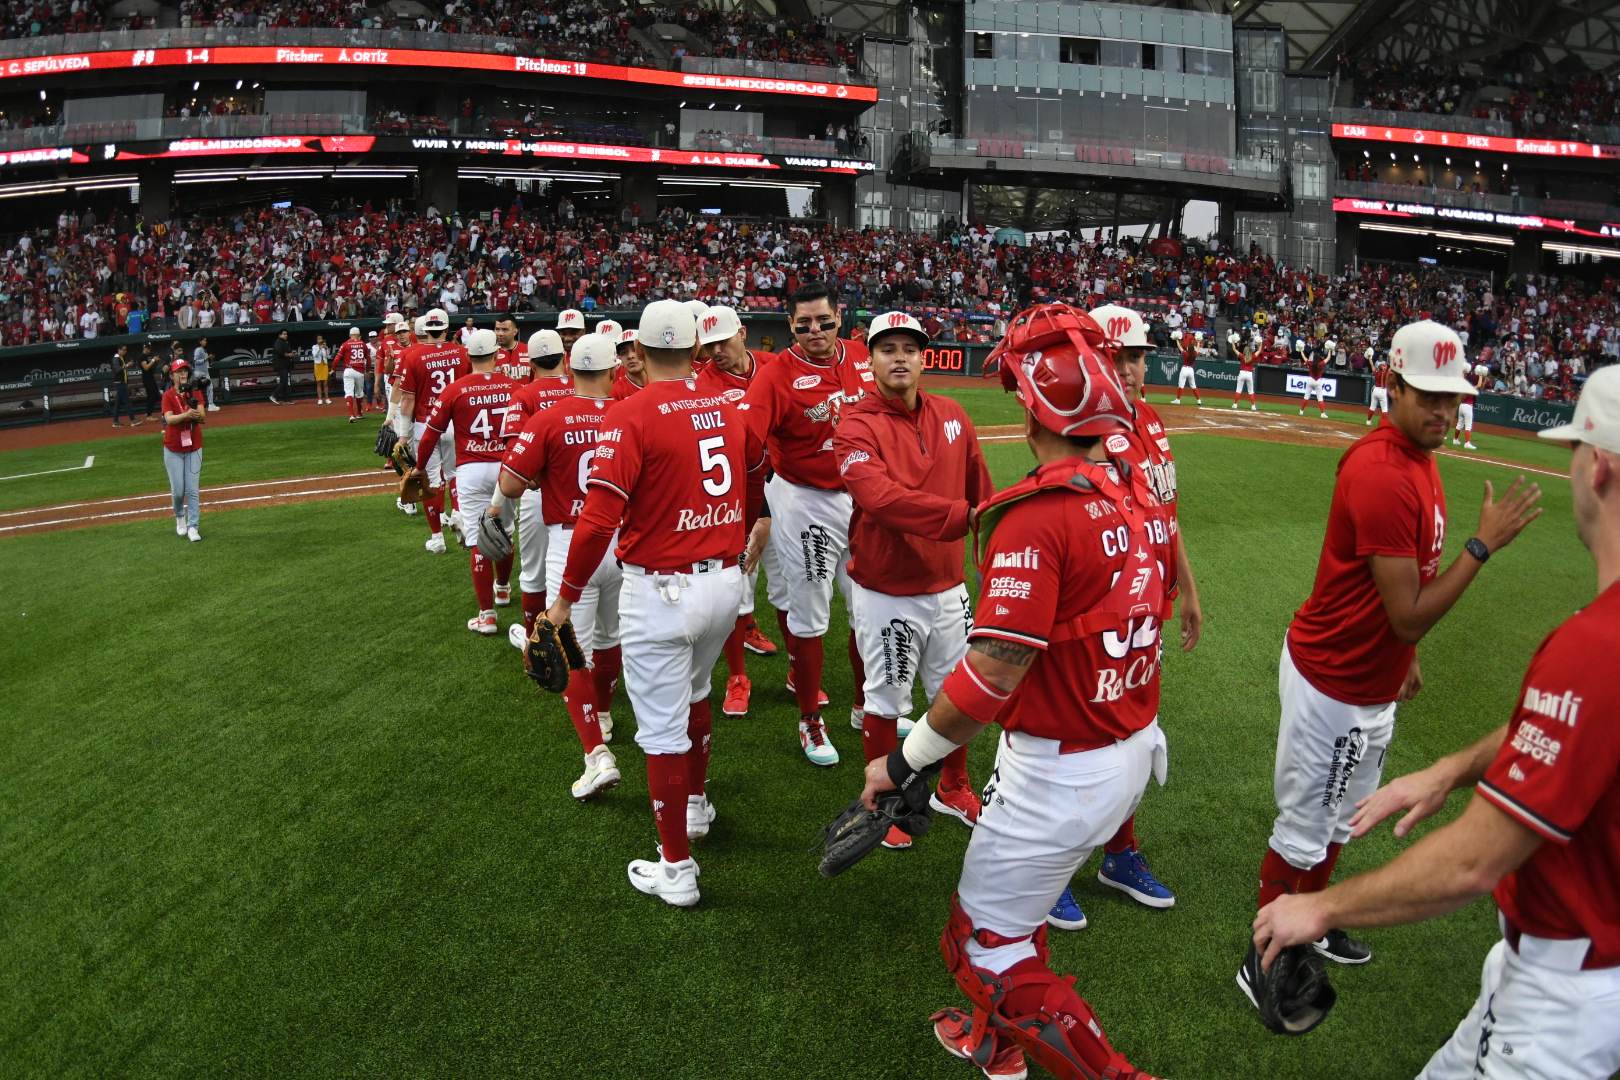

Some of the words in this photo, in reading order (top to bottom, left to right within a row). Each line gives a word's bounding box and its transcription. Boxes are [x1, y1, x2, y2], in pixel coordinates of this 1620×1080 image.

[187, 49, 209, 63] 1-4
[277, 49, 323, 62] Pitcher:
[353, 50, 388, 62] ORTÍZ
[9, 63, 21, 73] C.
[24, 56, 90, 71] SEPÚLVEDA
[515, 56, 571, 74] Pitcheos:
[574, 63, 587, 75] 19
[683, 75, 828, 95] #DELMEXICOROJO
[1343, 126, 1366, 137] CAM
[1385, 130, 1392, 140] 4
[168, 139, 302, 152] #DELMEXICOROJO
[412, 139, 448, 149] VIVIR
[452, 140, 462, 149] Y
[465, 140, 509, 151] MORIR
[513, 143, 575, 154] JUGANDO
[1441, 134, 1447, 144] 5
[1466, 136, 1489, 148] MEX
[1516, 139, 1556, 154] Entrada
[691, 155, 700, 164] A
[704, 156, 722, 165] LA
[725, 158, 770, 167] DIABLA
[784, 156, 828, 168] VAMOS
[1351, 200, 1383, 211] VIVIR
[1385, 202, 1395, 212] Y
[1397, 204, 1435, 216] MORIR
[1438, 207, 1494, 222] JUGANDO
[350, 348, 364, 359] 36
[922, 348, 962, 370] 0:00
[426, 357, 461, 370] ORNELAS
[430, 367, 456, 395] 31
[468, 382, 513, 393] INTERCERAMIC
[469, 392, 512, 406] GAMBOA
[546, 388, 576, 397] INTERCE
[670, 394, 730, 412] INTERCERAMIC
[1474, 404, 1500, 414] CERAMIC
[469, 406, 508, 440] 47
[575, 414, 606, 423] INTERC
[690, 410, 726, 431] RUIZ
[697, 434, 733, 497] 5
[801, 539, 813, 582] caliente.mx
[990, 577, 1032, 591] Office
[987, 588, 1030, 600] DEPOT
[882, 637, 894, 686] caliente.mx
[1517, 720, 1562, 755] Office
[1321, 748, 1342, 808] caliente.mx
